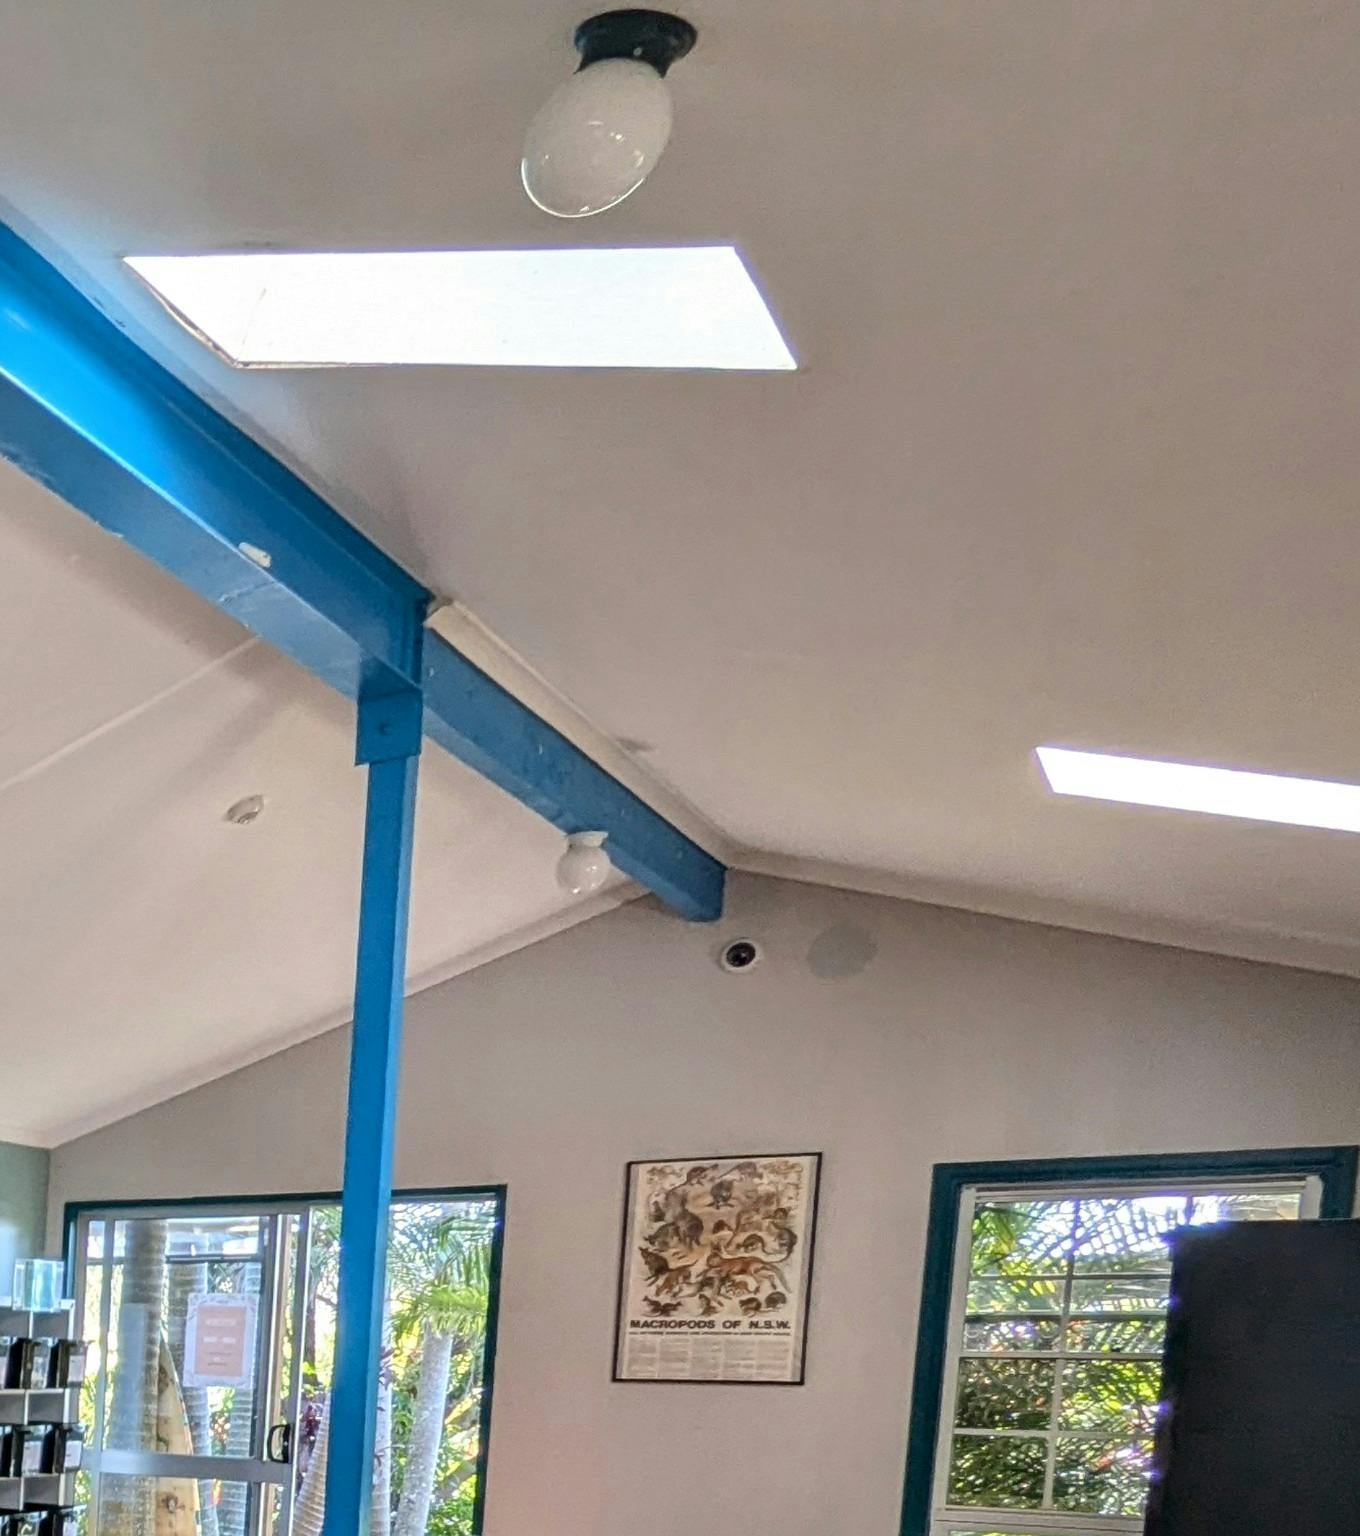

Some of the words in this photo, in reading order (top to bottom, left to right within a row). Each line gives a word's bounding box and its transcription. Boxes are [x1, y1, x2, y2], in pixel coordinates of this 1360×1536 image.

[630, 1319, 716, 1329] MACROPODS
[722, 1319, 742, 1329] OF
[748, 1319, 791, 1329] N.S.W.
